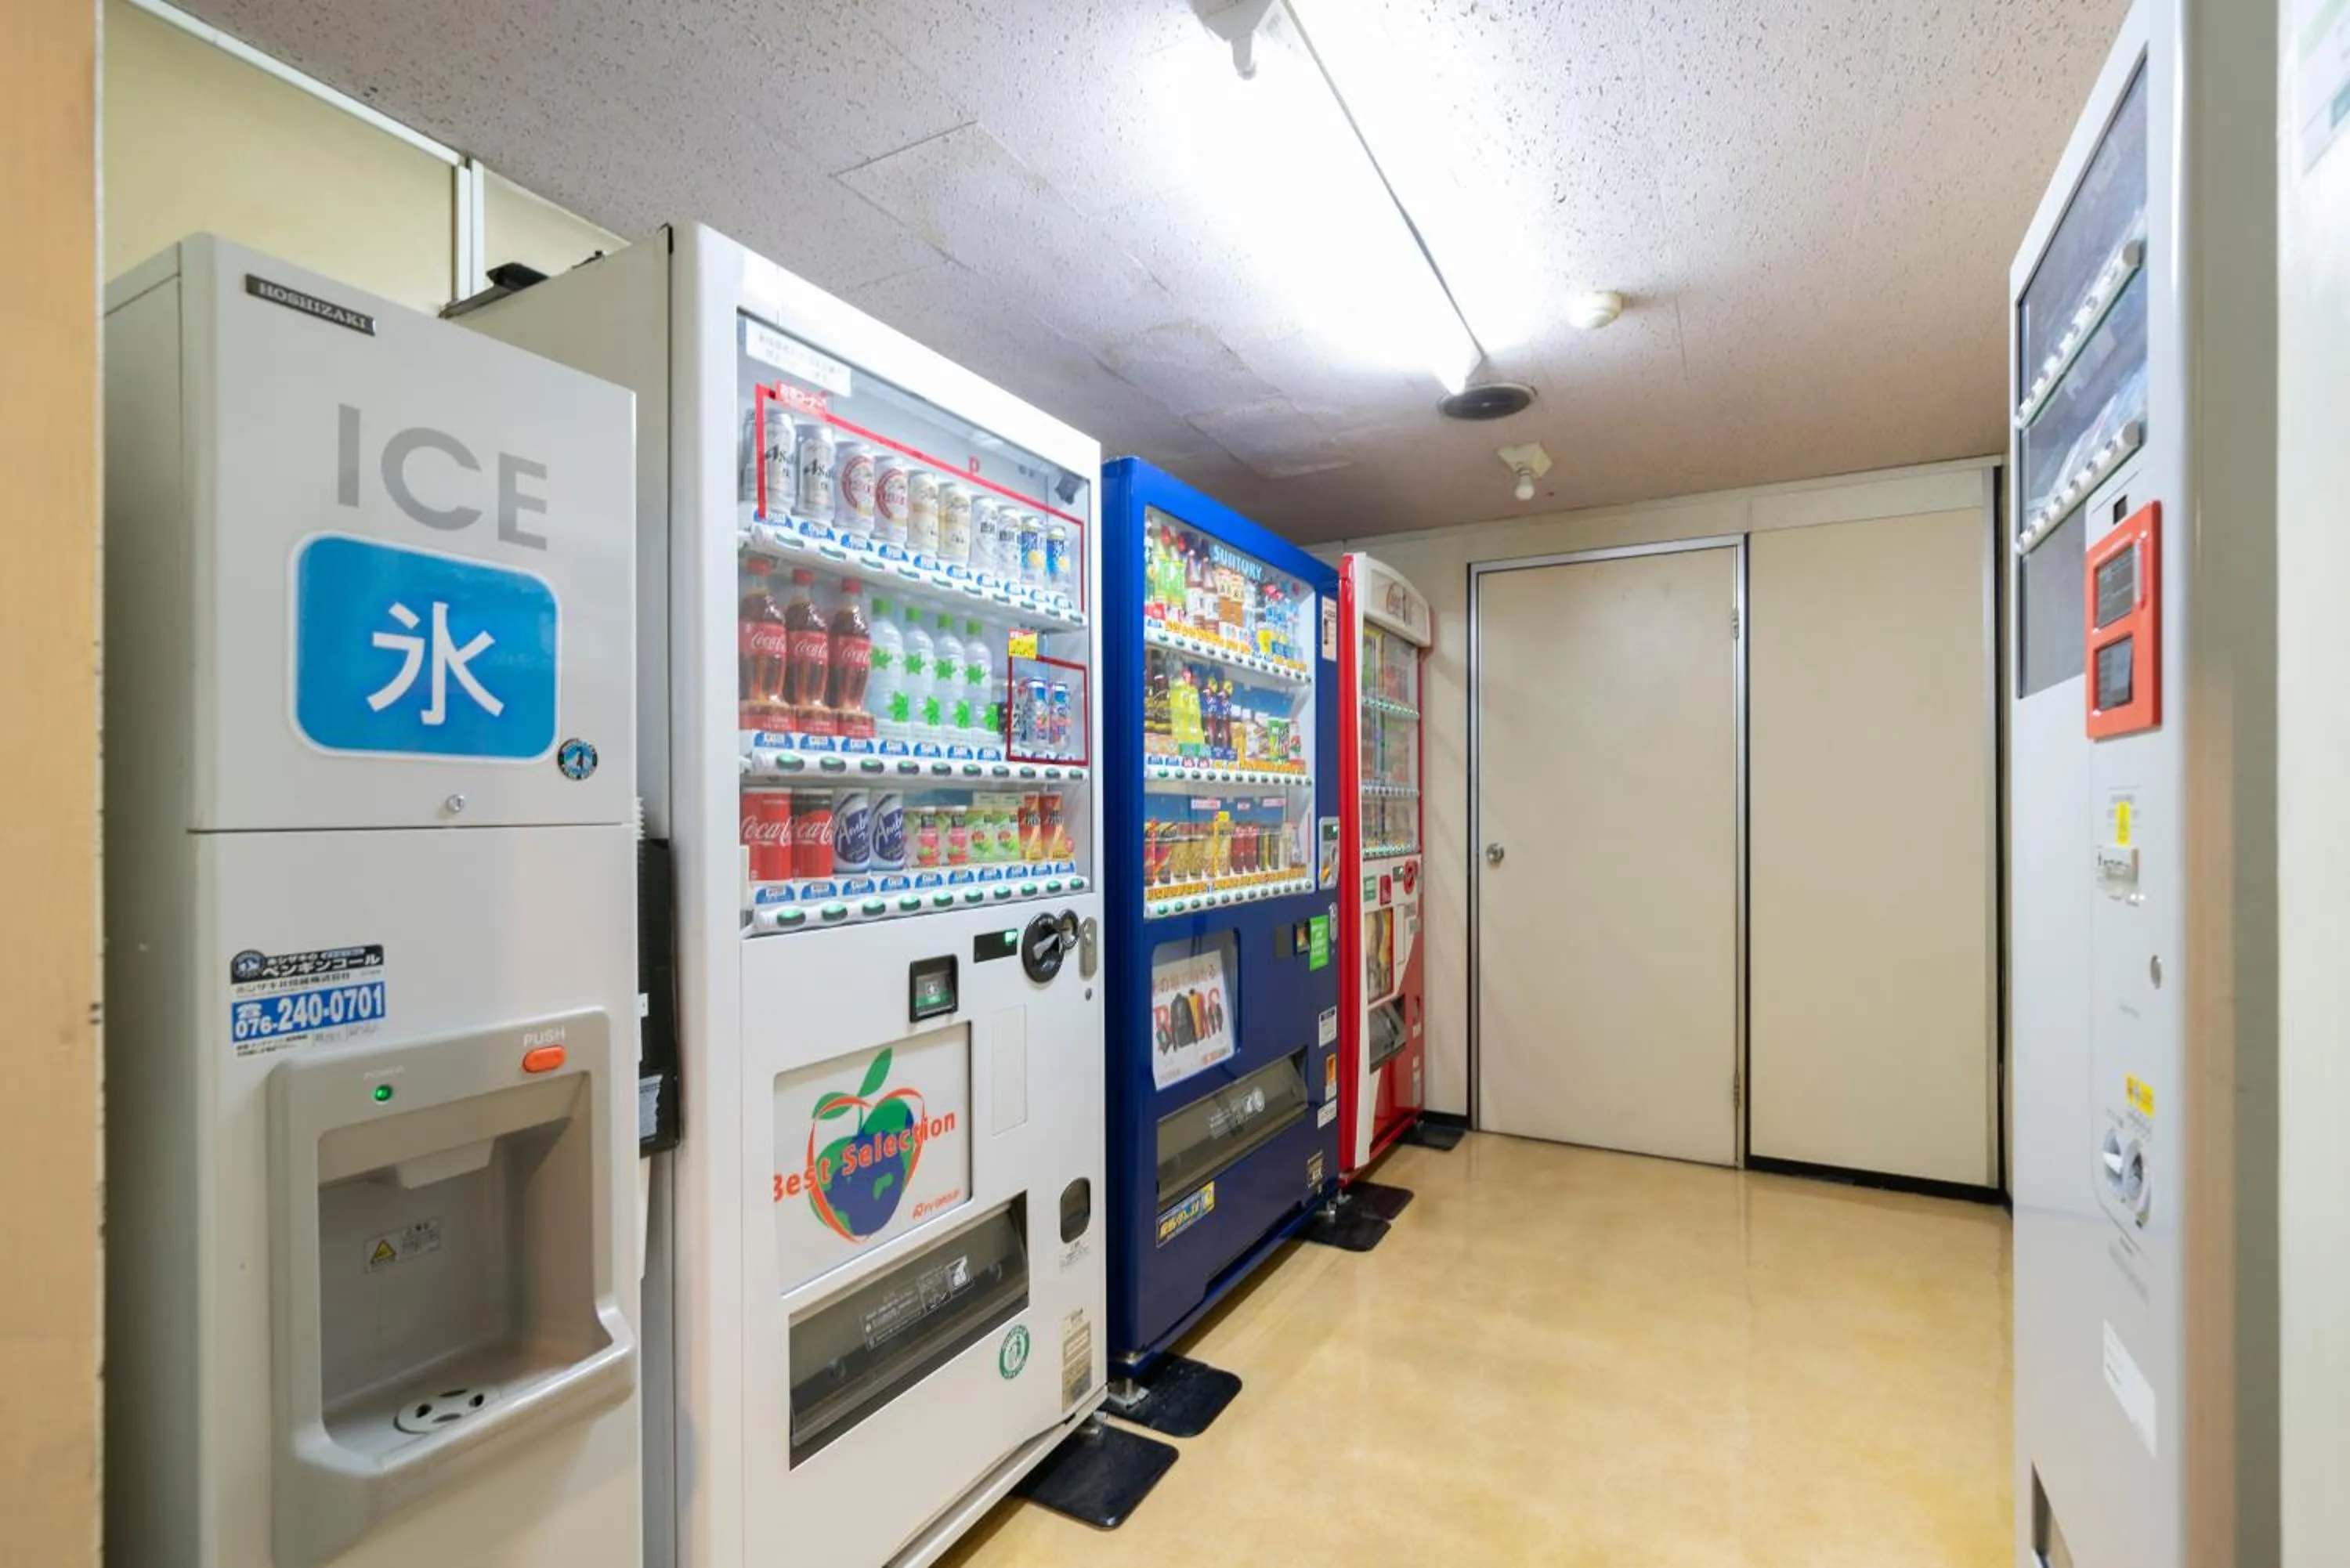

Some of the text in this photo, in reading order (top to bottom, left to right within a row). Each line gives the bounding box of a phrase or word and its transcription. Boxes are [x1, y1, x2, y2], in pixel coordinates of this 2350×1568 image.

[258, 282, 367, 329] HOSHIZAKI
[337, 403, 548, 551] ICE
[1212, 544, 1264, 581] SUNTORY
[366, 601, 505, 727] 氷
[262, 953, 381, 977] ペンギンコール
[235, 985, 383, 1039] 076-240-0701
[522, 1027, 566, 1047] PUSH
[363, 1065, 405, 1081] POWER
[841, 1111, 956, 1176] Selection
